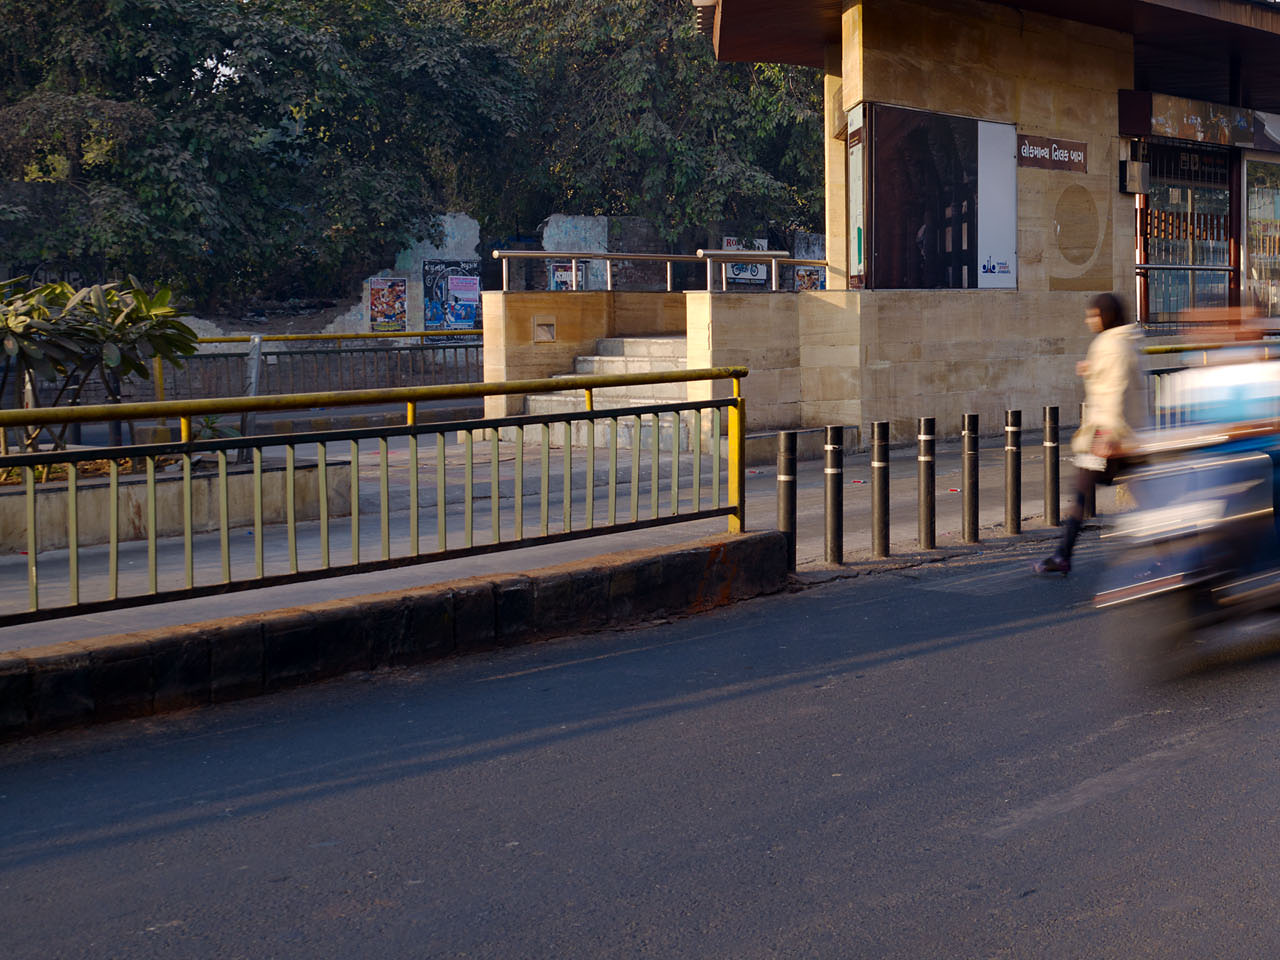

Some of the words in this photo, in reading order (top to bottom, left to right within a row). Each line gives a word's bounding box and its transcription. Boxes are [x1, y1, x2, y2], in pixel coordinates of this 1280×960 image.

[1021, 140, 1049, 159] લોકમાન્ય
[1051, 143, 1069, 161] તિલક
[1070, 150, 1084, 163] બાગ
